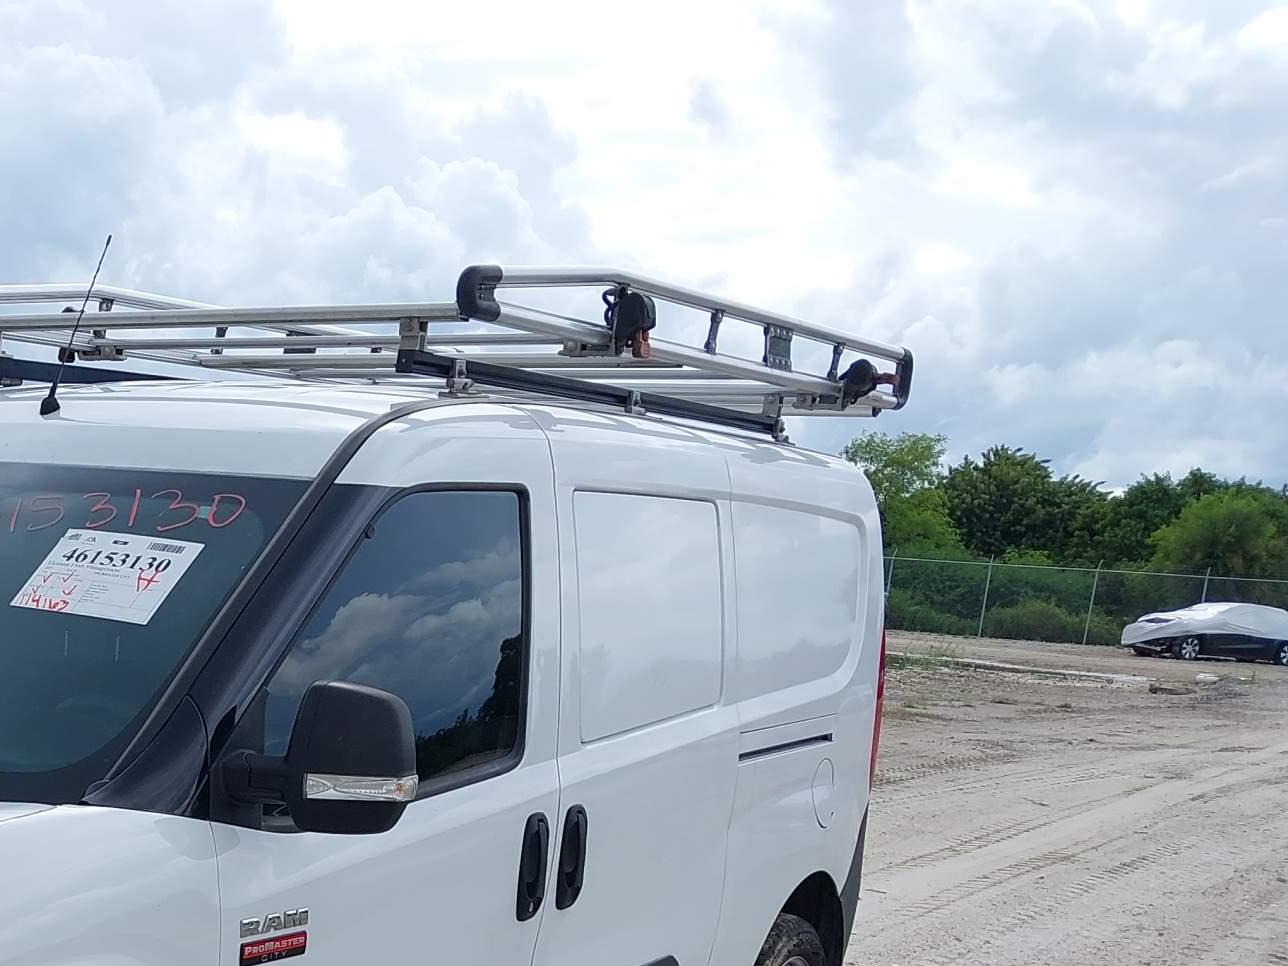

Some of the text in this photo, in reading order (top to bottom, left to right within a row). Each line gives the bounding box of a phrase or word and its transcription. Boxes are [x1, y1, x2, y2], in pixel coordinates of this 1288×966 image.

[62, 547, 172, 573] 46153130
[240, 907, 309, 938] RAM
[261, 951, 289, 962] CITY
